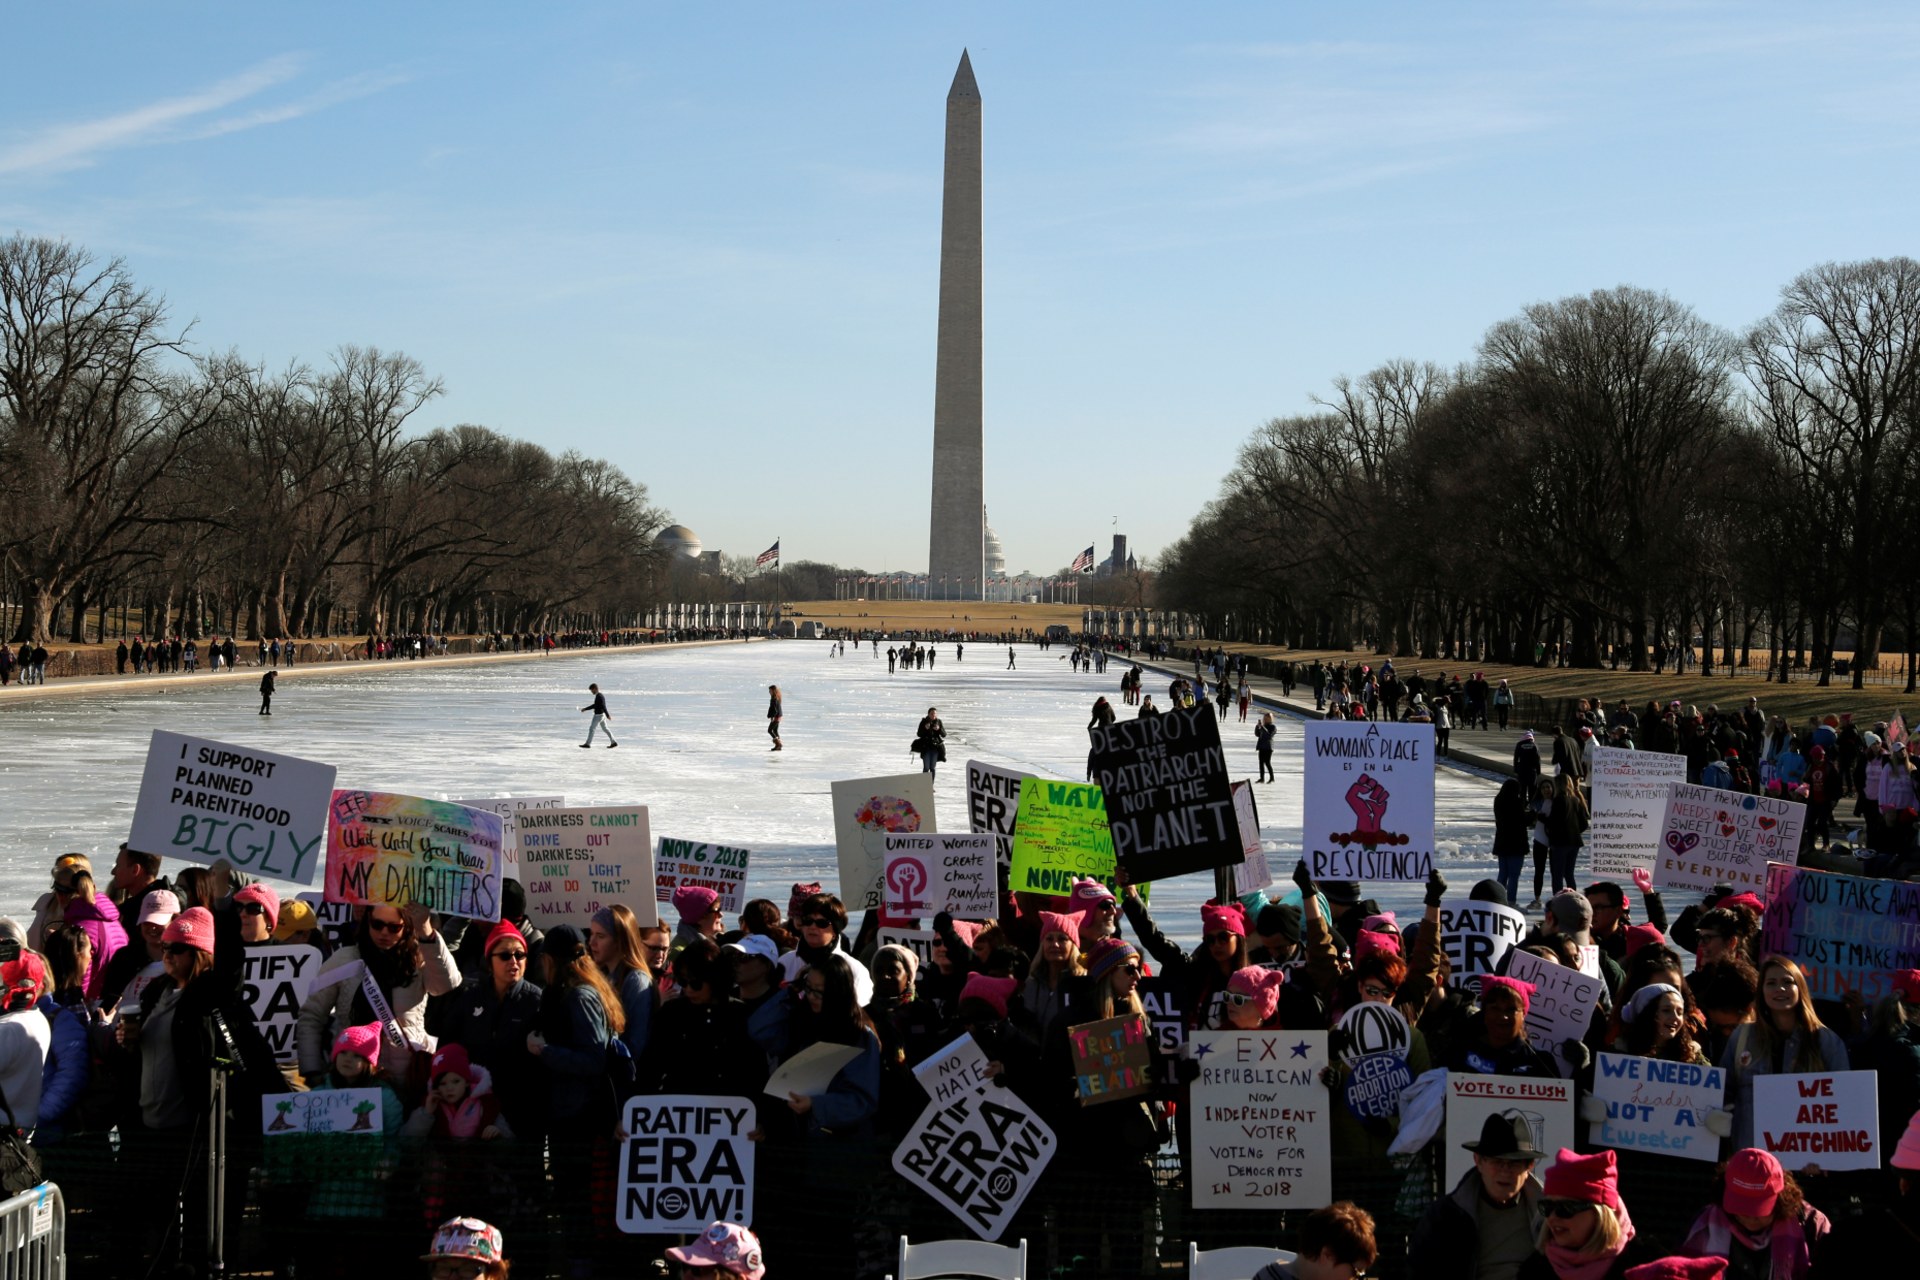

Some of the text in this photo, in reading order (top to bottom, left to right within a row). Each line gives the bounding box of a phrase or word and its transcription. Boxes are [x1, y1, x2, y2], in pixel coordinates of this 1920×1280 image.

[1091, 707, 1203, 754] DESTROY
[1367, 723, 1379, 737] A
[181, 743, 276, 778] I SUPPORT
[1136, 744, 1167, 761] THE
[1315, 736, 1419, 761] WOMAN'S PLACE
[1101, 746, 1222, 795] PATRIARCHY
[1344, 762, 1393, 772] ES EN LA
[175, 766, 253, 796] PLANNED
[969, 767, 1021, 800] RATIF
[170, 788, 290, 826] PARENTHOOD
[339, 793, 365, 815] IF
[1027, 783, 1106, 810] A WAV
[1122, 778, 1208, 814] NOT THE
[1635, 790, 1669, 799] ATTENTIO
[1675, 785, 1713, 802] WHAT
[1715, 792, 1729, 804] the
[590, 814, 639, 827] CANNOT
[1672, 802, 1711, 822] NEEDS
[1713, 810, 1735, 823] NOW
[1737, 815, 1749, 827] IS
[397, 816, 434, 828] VOICE
[434, 824, 469, 838] SCARES
[470, 834, 498, 849] YOU
[524, 834, 611, 846] DRIVE OUT
[1111, 801, 1230, 857] PLANET
[1668, 818, 1712, 834] SWEET
[1756, 832, 1794, 849] NOT
[172, 814, 322, 878] BIGLY
[343, 829, 377, 848] Wait
[457, 844, 484, 870] hear
[527, 848, 595, 862] DARKNESS;
[661, 839, 694, 859] NOV
[713, 846, 748, 868] 2018
[886, 838, 988, 850] UNITED WOMEN
[1701, 836, 1795, 862] JUST FOR SOME
[542, 864, 622, 877] ONLY LIGHT
[658, 861, 744, 880] ITS TIME TO TAKE
[1042, 852, 1115, 872] IS COMI
[1313, 849, 1432, 880] RESISTENCIA
[1707, 850, 1753, 867] BUT FOR
[656, 875, 736, 894] OUR COUNTRY
[1665, 859, 1763, 885] EVERYONE
[340, 861, 495, 918] MY DAUGHTERS
[530, 881, 552, 893] CAN
[565, 880, 579, 892] DO
[1768, 868, 1920, 920] IF YOU TAKE AWA
[1440, 909, 1523, 943] RATIFY
[1765, 902, 1920, 948] MY BIRTH CONTR
[1440, 934, 1496, 974] ER
[1793, 934, 1893, 969] JUST MAKE
[245, 954, 311, 980] TIFY
[1509, 953, 1592, 1003] White
[1072, 1018, 1145, 1059] TRUTH
[1338, 1005, 1406, 1058] NOW
[1237, 1037, 1277, 1062] EX
[939, 1056, 961, 1076] NO
[1203, 1068, 1312, 1086] REPUBLICAN
[1354, 1057, 1394, 1083] KEEP
[1600, 1055, 1721, 1090] WE NEED A
[935, 1059, 986, 1102] HATE
[1077, 1064, 1153, 1099] RELATIVE
[1348, 1067, 1412, 1106] ABORTION
[1453, 1081, 1494, 1094] VOTE
[1520, 1084, 1566, 1097] FLUSH
[1797, 1078, 1833, 1098] WE
[1249, 1092, 1277, 1103] NOW
[1631, 1082, 1694, 1107] Leader
[631, 1106, 748, 1136] RATIFY
[1205, 1106, 1317, 1123] INDEPENDENT
[1674, 1109, 1695, 1127] A
[1796, 1104, 1838, 1124] ARE
[901, 1087, 985, 1178] RATIF
[1242, 1125, 1297, 1142] VOTER
[1602, 1122, 1694, 1150] tweeter
[1763, 1130, 1873, 1153] WATCHING
[627, 1137, 746, 1185] ERA
[926, 1100, 1026, 1208] ERA
[1210, 1146, 1305, 1160] VOTING FOR
[966, 1119, 1049, 1231] NOW!
[1228, 1165, 1303, 1177] DEMOCRATS
[1212, 1182, 1292, 1197] IN 2018
[625, 1186, 744, 1222] NOW!
